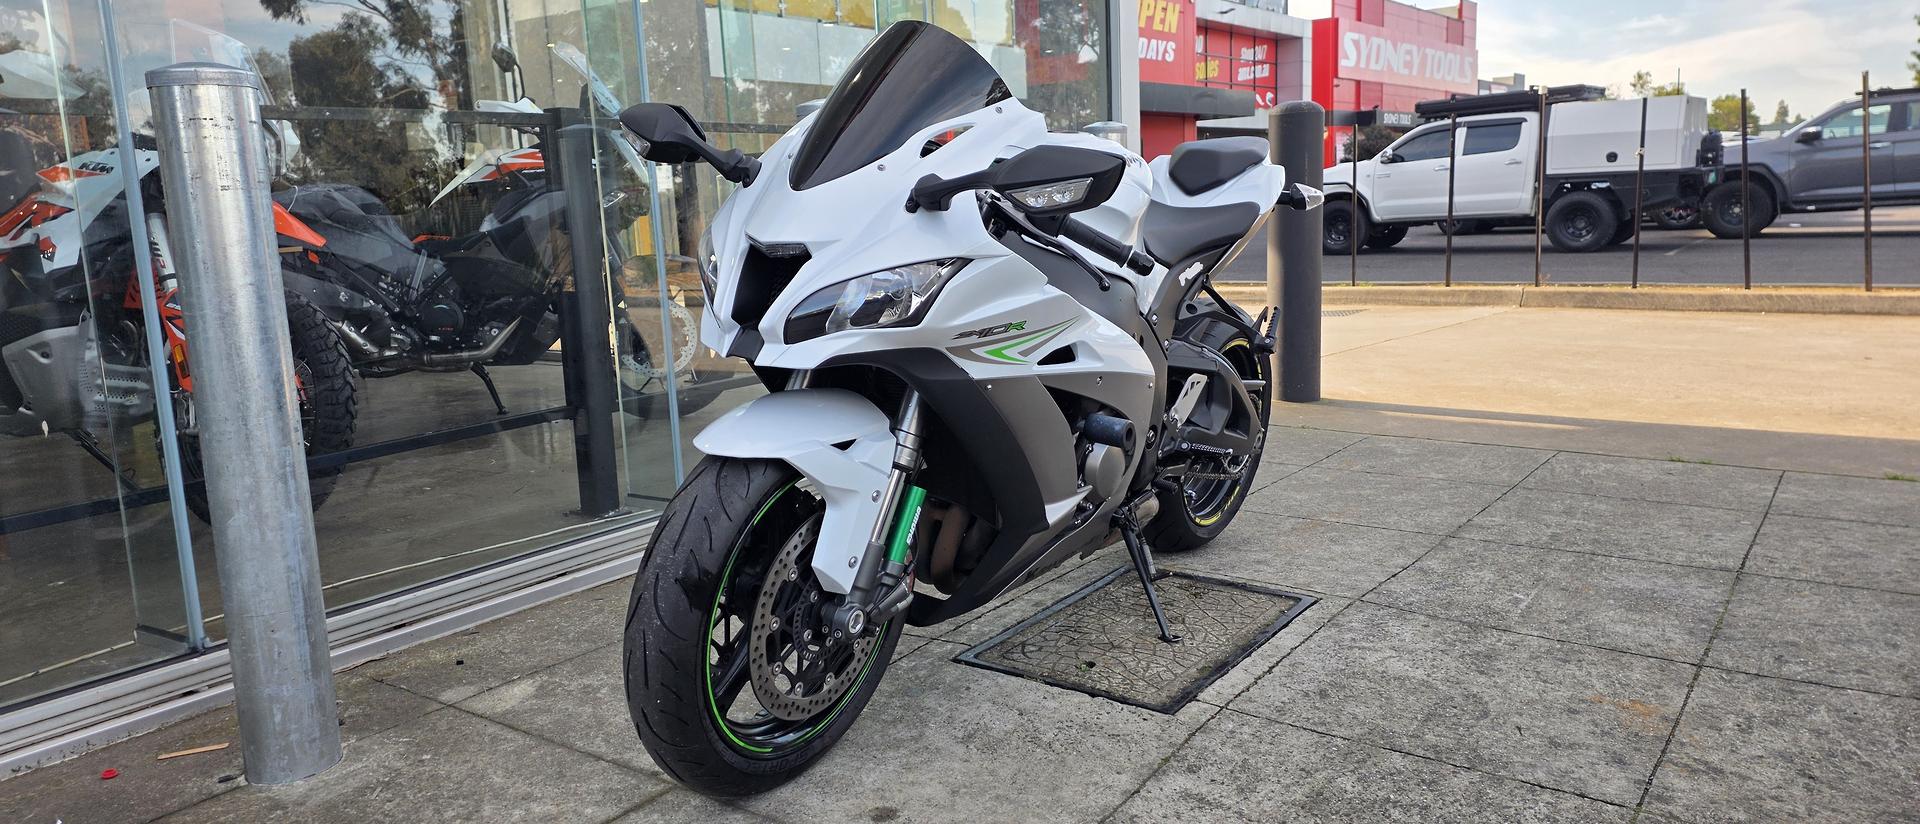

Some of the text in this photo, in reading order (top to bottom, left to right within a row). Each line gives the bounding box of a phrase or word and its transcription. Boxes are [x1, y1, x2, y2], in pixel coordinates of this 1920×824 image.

[1138, 0, 1181, 34] PEN
[1138, 37, 1176, 62] DAYS
[1340, 31, 1474, 84] SYDNEY TOOLS
[1383, 112, 1412, 125] SYDNEY TOOLS
